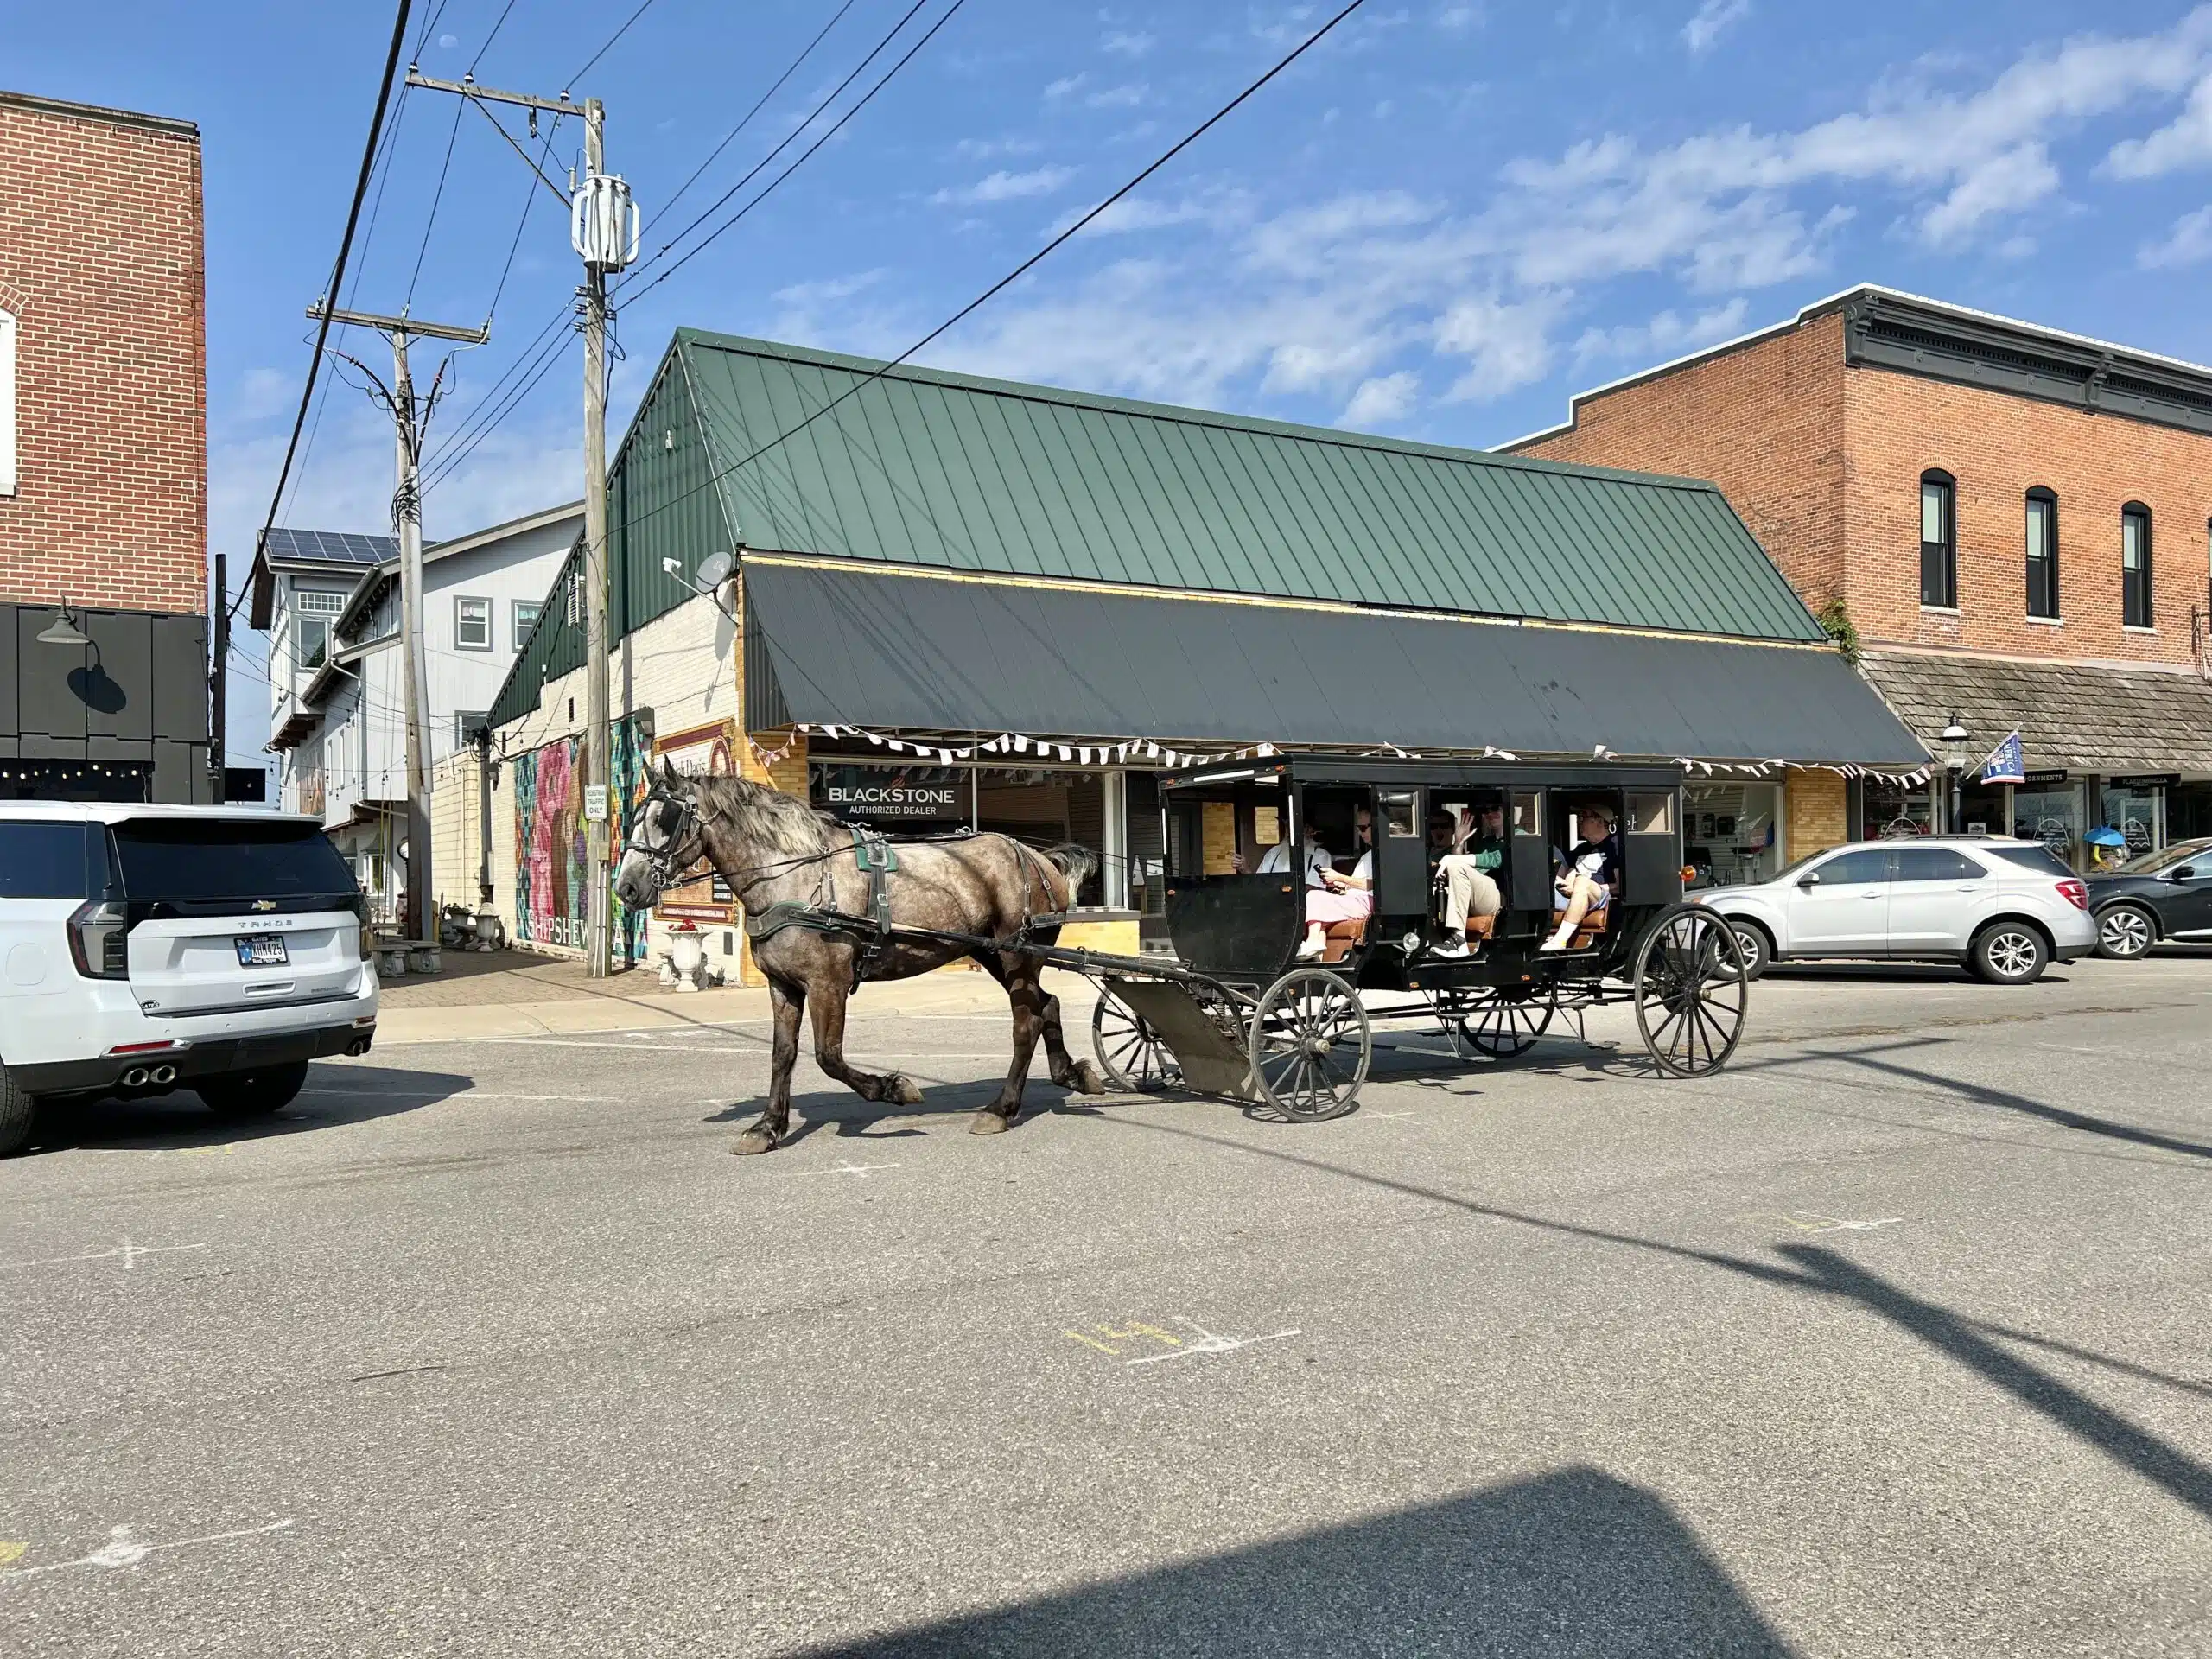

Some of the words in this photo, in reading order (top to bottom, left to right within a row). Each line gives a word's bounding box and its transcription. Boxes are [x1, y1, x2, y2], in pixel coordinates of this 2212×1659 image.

[829, 787, 955, 804] BLACKSTONE
[849, 805, 901, 815] AUTHORIZED
[903, 806, 937, 815] DEALER
[238, 919, 293, 928] TAHOE
[528, 909, 625, 952] SHIPSHEWA
